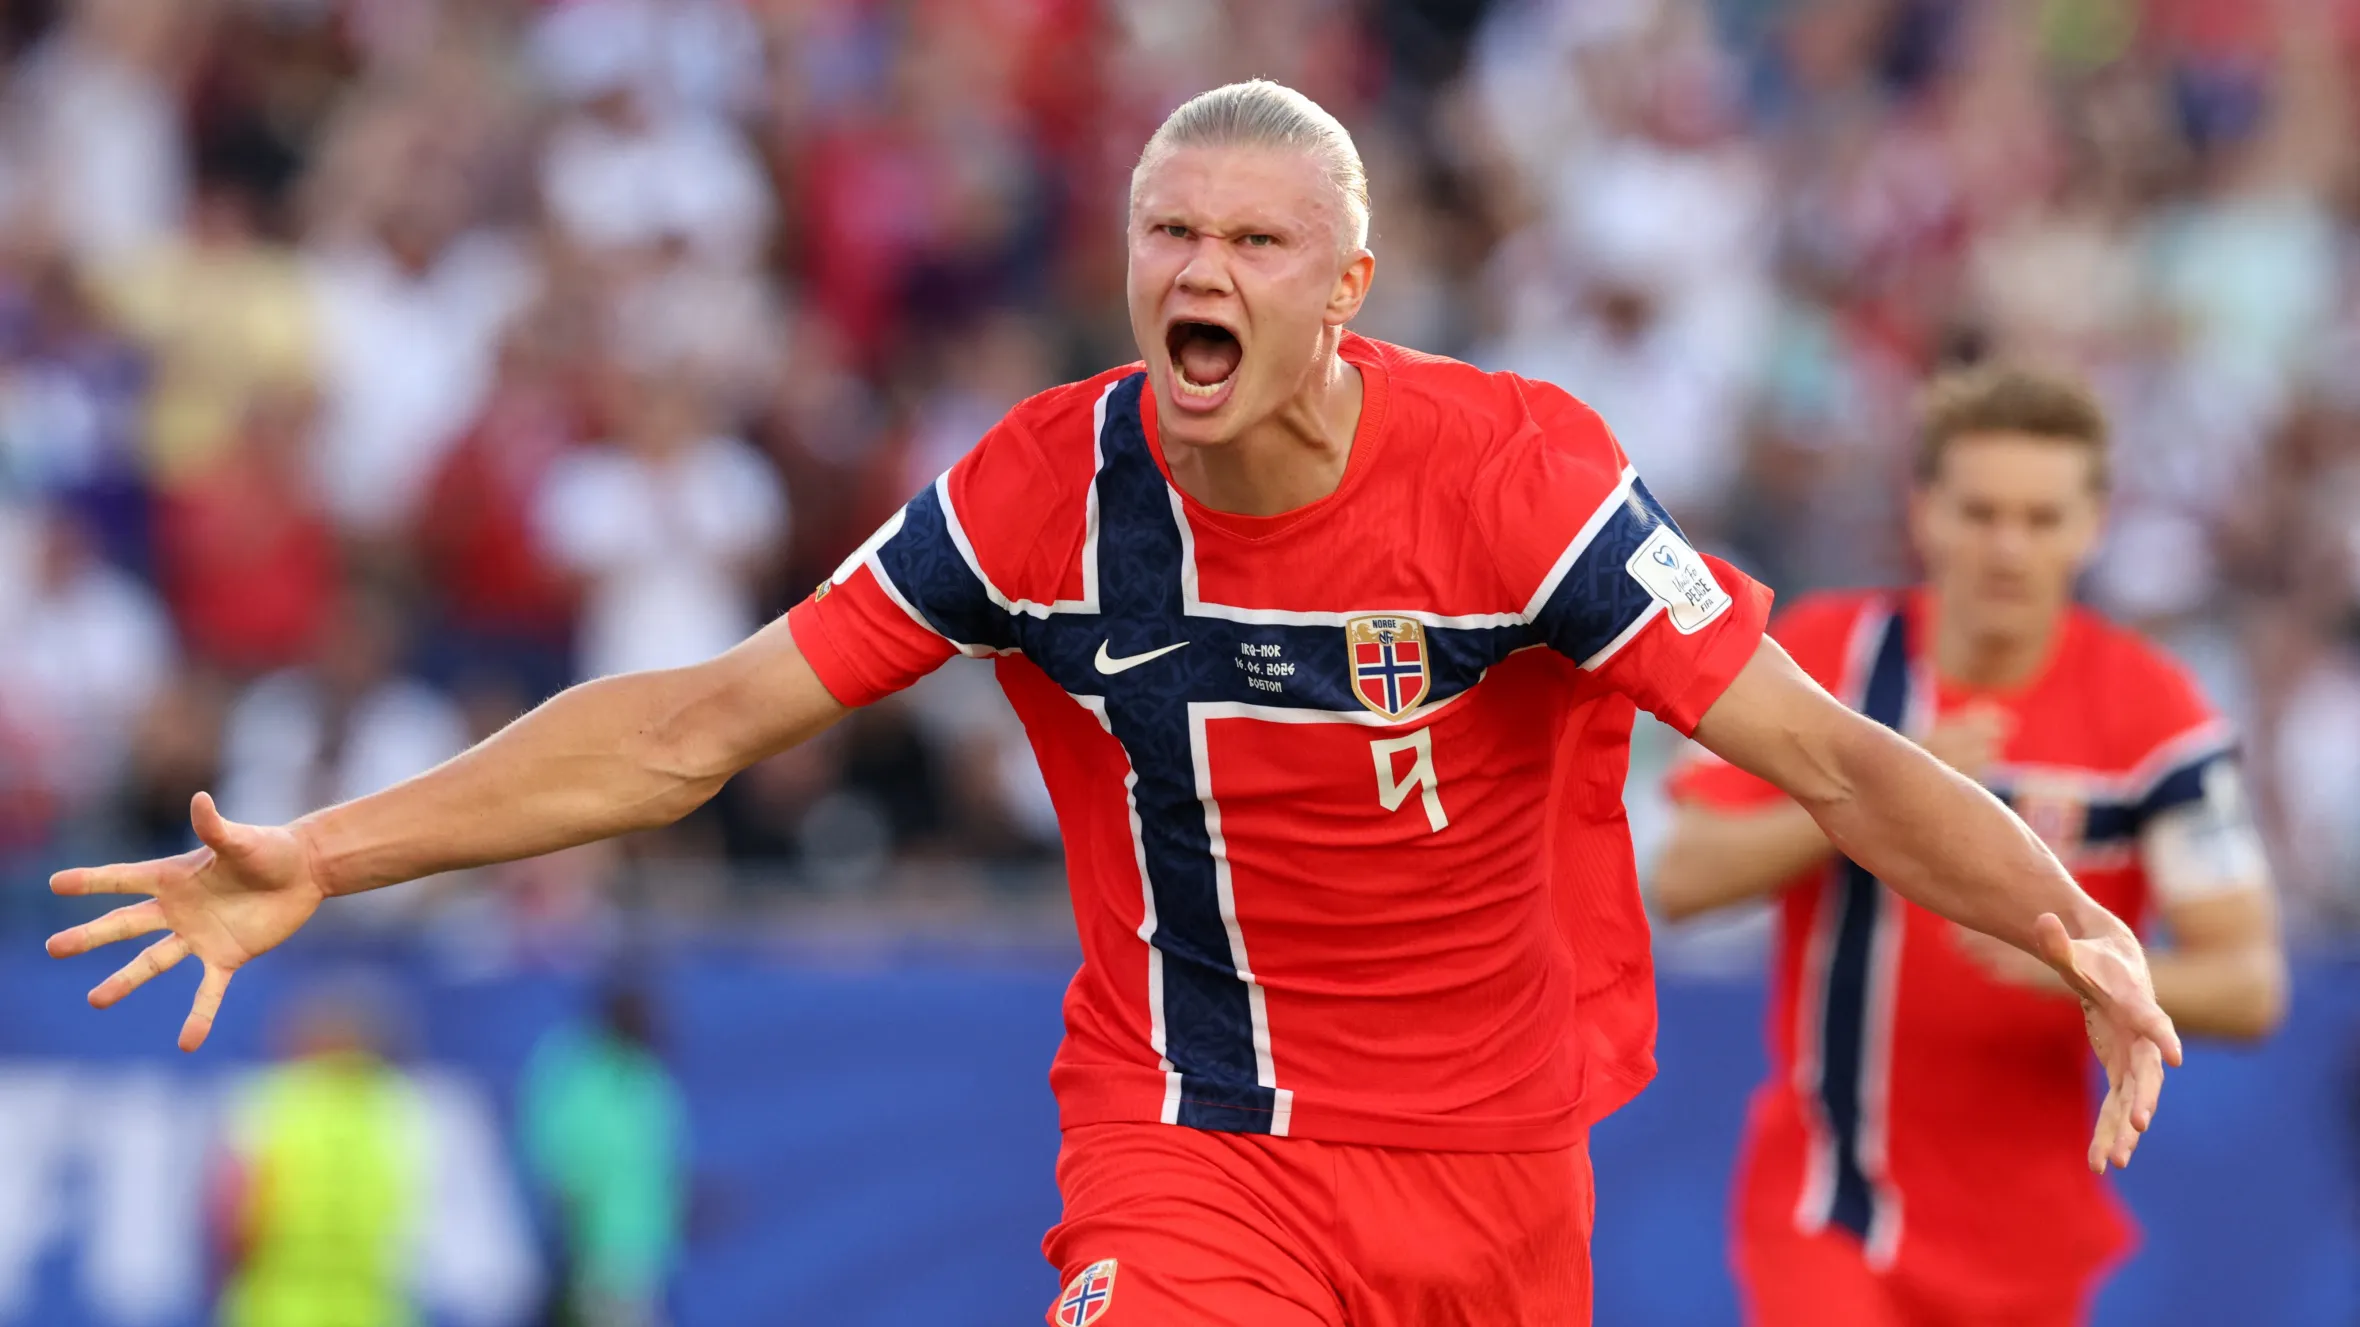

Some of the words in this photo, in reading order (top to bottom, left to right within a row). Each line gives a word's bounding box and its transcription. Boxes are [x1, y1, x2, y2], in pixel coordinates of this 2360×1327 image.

[1684, 578, 1711, 607] PEACE
[1700, 598, 1714, 613] FIFA
[1372, 619, 1397, 629] NORGE
[1240, 642, 1282, 658] IRQ-NOR
[1247, 675, 1283, 693] BOSTON
[1369, 726, 1449, 833] 9
